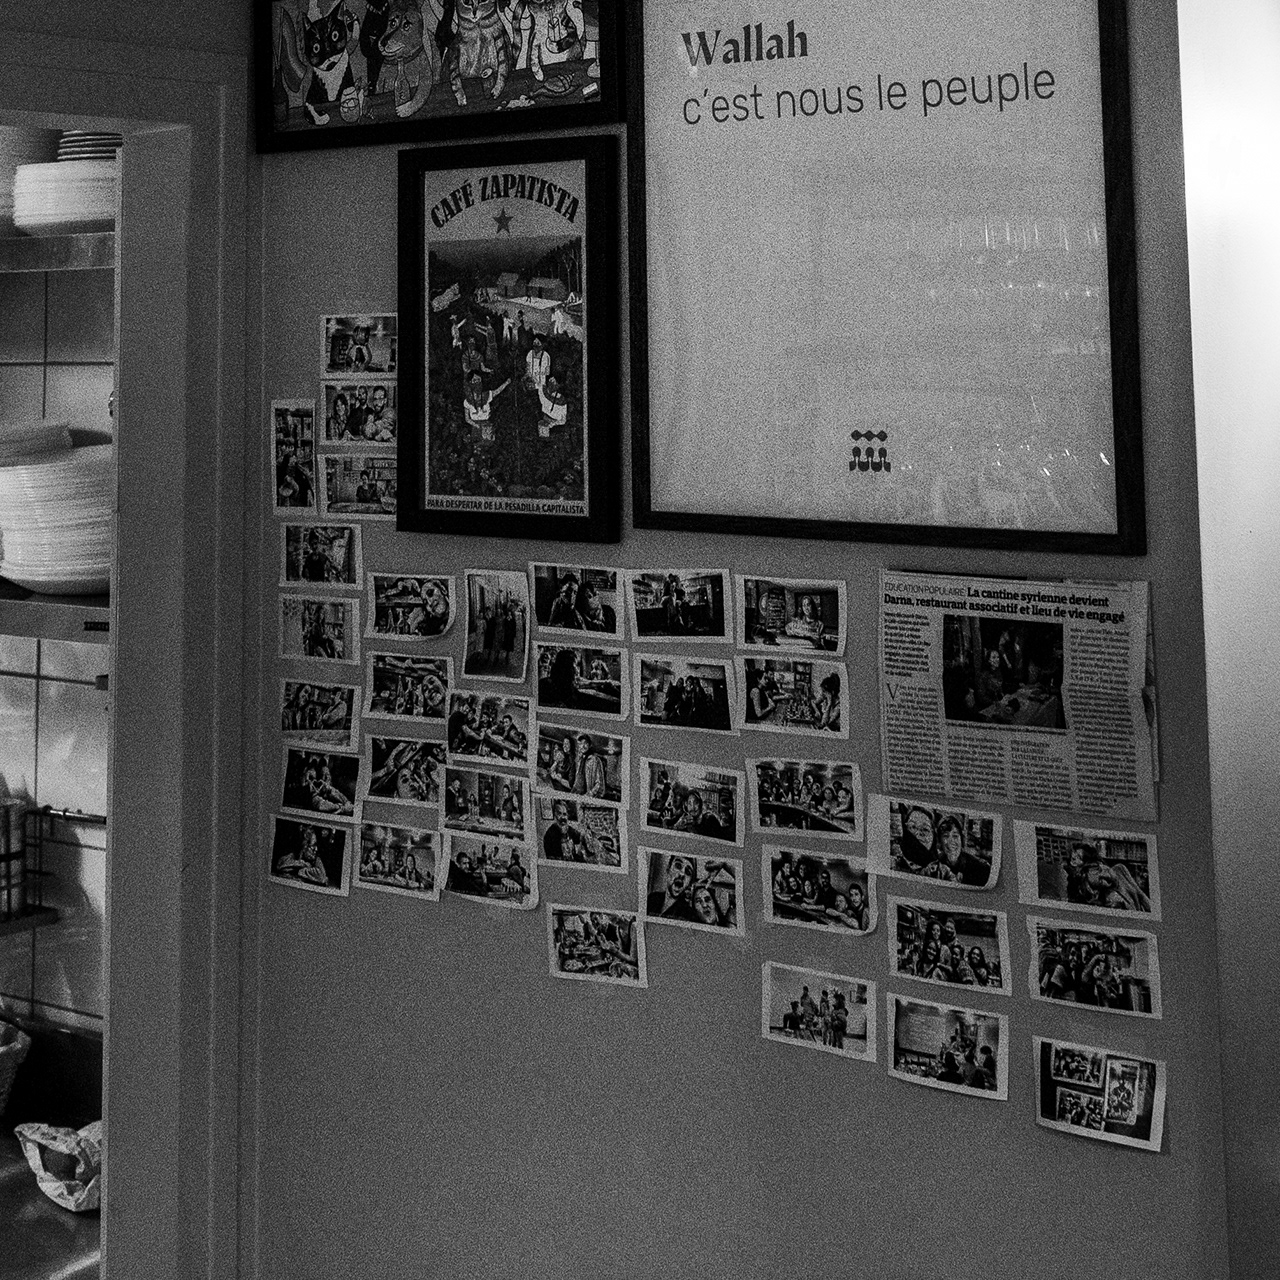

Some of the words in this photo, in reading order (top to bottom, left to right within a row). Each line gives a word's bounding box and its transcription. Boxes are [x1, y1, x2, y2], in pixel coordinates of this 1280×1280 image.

[681, 19, 808, 67] Wallah
[776, 82, 864, 119] nous
[878, 74, 909, 111] le
[921, 62, 1057, 116] peuple
[430, 179, 474, 228] CAFÉ
[479, 173, 580, 224] ZAPATISTA
[426, 499, 445, 508] PARA
[446, 499, 482, 510] DESPERTAR
[484, 501, 493, 510] DE
[494, 502, 504, 511] LA
[505, 502, 540, 512] PESADILLA
[542, 504, 585, 515] CAPITALISTA
[884, 593, 915, 607] Darna,
[915, 597, 968, 610] restaurant
[968, 600, 1018, 614] associatif
[1019, 604, 1030, 614] et
[1031, 604, 1052, 616] lieu
[1053, 606, 1067, 617] de
[1067, 607, 1085, 620] vie
[1086, 610, 1125, 624] engagé
[967, 587, 979, 599] La
[981, 589, 1020, 601] cantine
[1020, 591, 1067, 604] syrienne
[1068, 594, 1109, 607] devient
